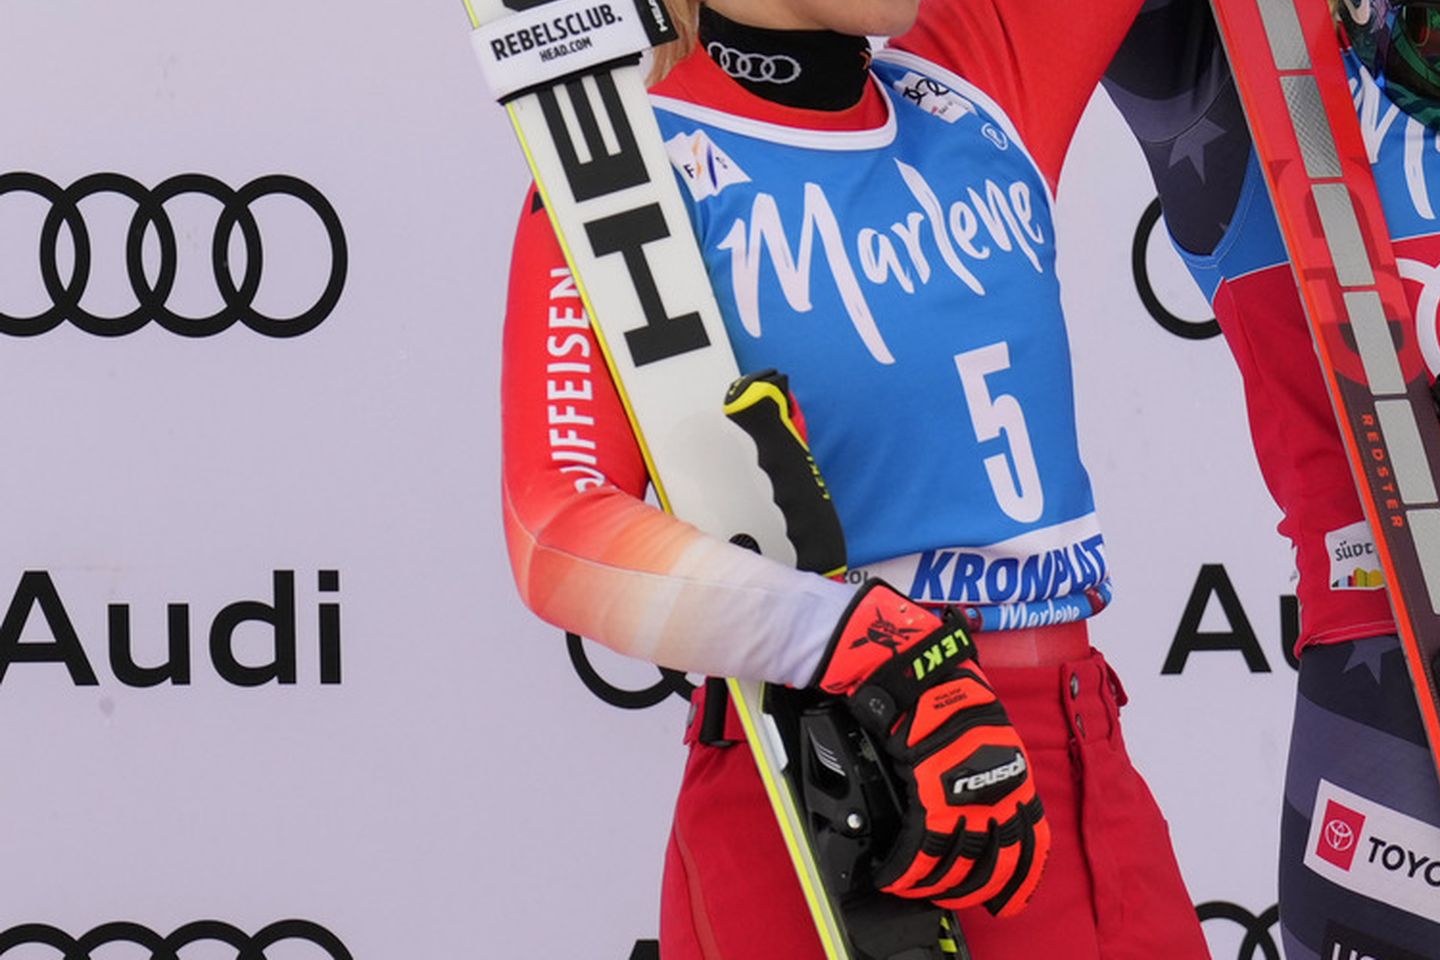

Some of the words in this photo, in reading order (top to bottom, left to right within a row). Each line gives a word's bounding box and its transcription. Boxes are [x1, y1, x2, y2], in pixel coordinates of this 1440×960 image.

[491, 4, 623, 61] REBELSCLUB.
[539, 36, 593, 63] HEAD.COM
[717, 156, 1045, 365] Marlene
[953, 341, 1045, 523] 5
[1361, 414, 1404, 528] REDSTER
[908, 534, 1109, 603] KRONPLAT
[0, 570, 342, 688] Audi
[912, 628, 970, 680] LEKI
